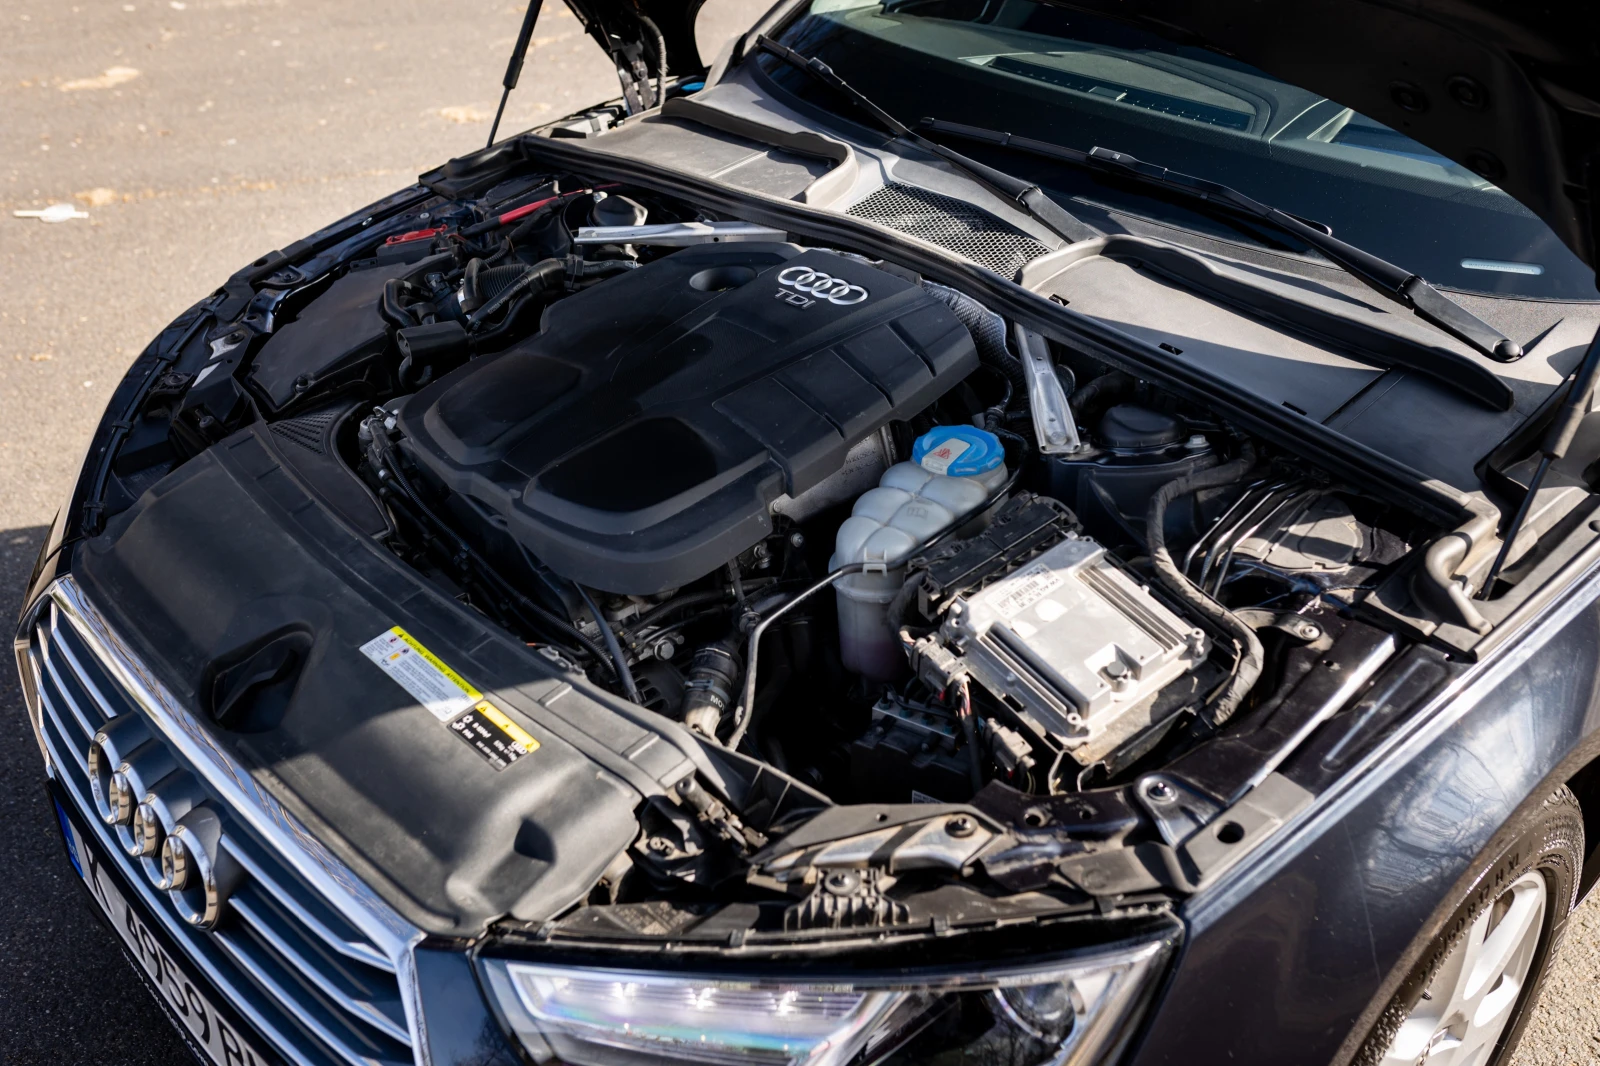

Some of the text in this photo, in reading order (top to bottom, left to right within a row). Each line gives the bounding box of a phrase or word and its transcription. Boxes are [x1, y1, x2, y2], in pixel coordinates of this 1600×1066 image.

[775, 287, 816, 309] TDI
[404, 638, 425, 655] ACHTUNG
[424, 654, 446, 673] WARNING
[446, 673, 470, 693] ATTENTION
